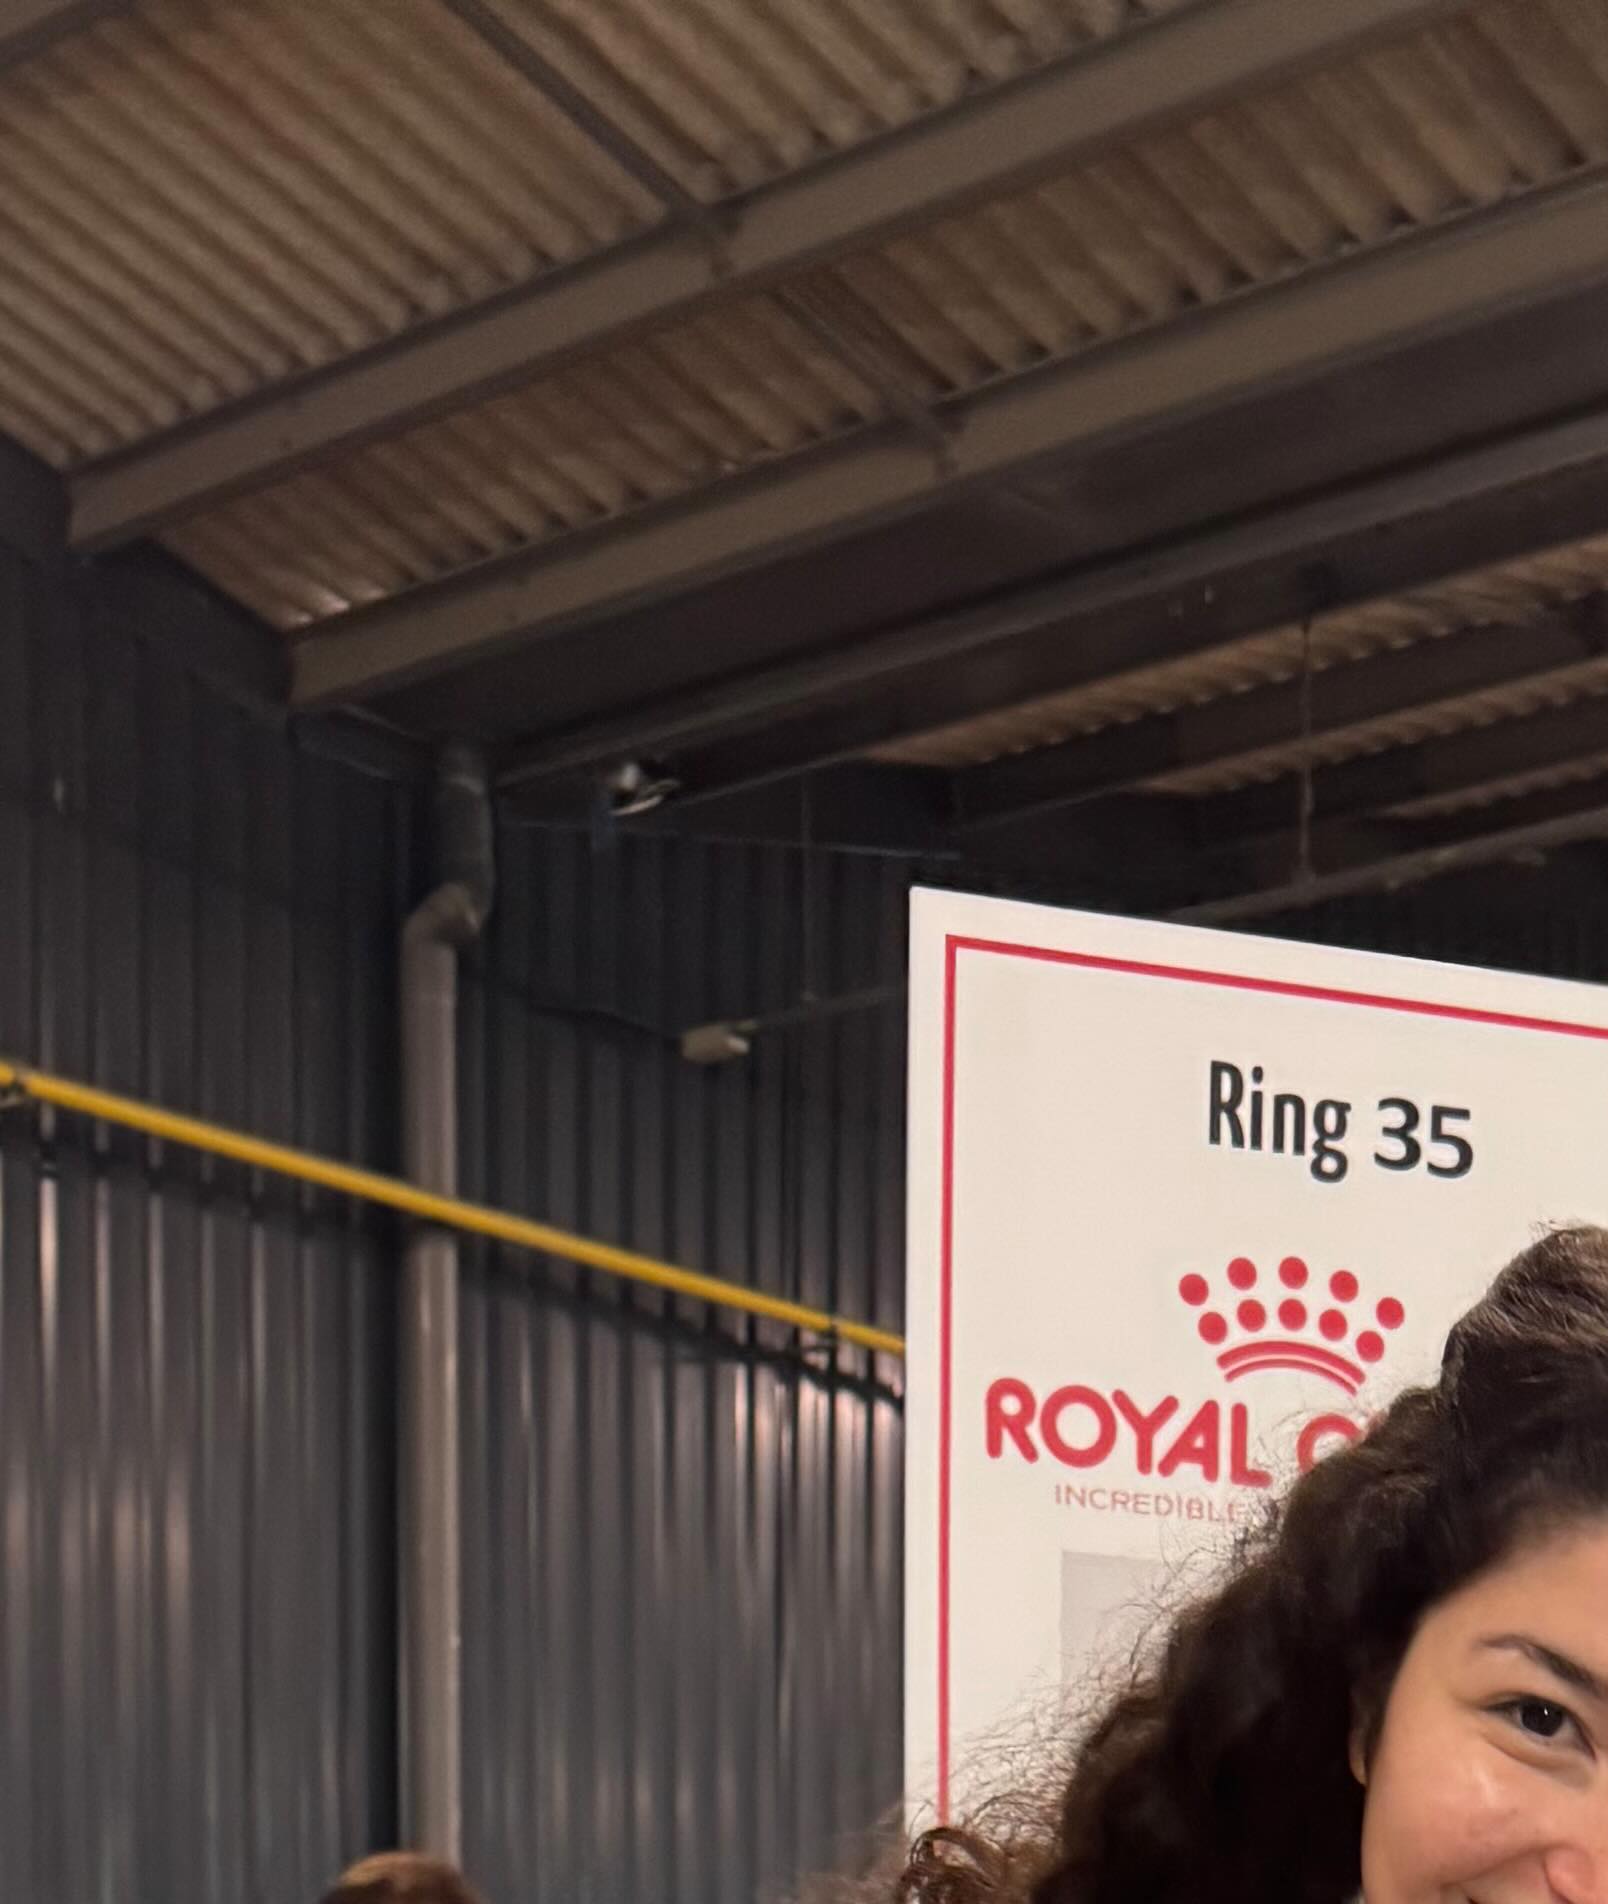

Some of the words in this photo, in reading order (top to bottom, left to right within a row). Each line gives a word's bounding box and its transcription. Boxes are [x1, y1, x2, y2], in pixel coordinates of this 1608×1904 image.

[1207, 1059, 1351, 1183] Ring
[1373, 1097, 1475, 1179] 35
[985, 1377, 1273, 1488] ROYAL
[1054, 1484, 1247, 1525] INCREDIBLE
